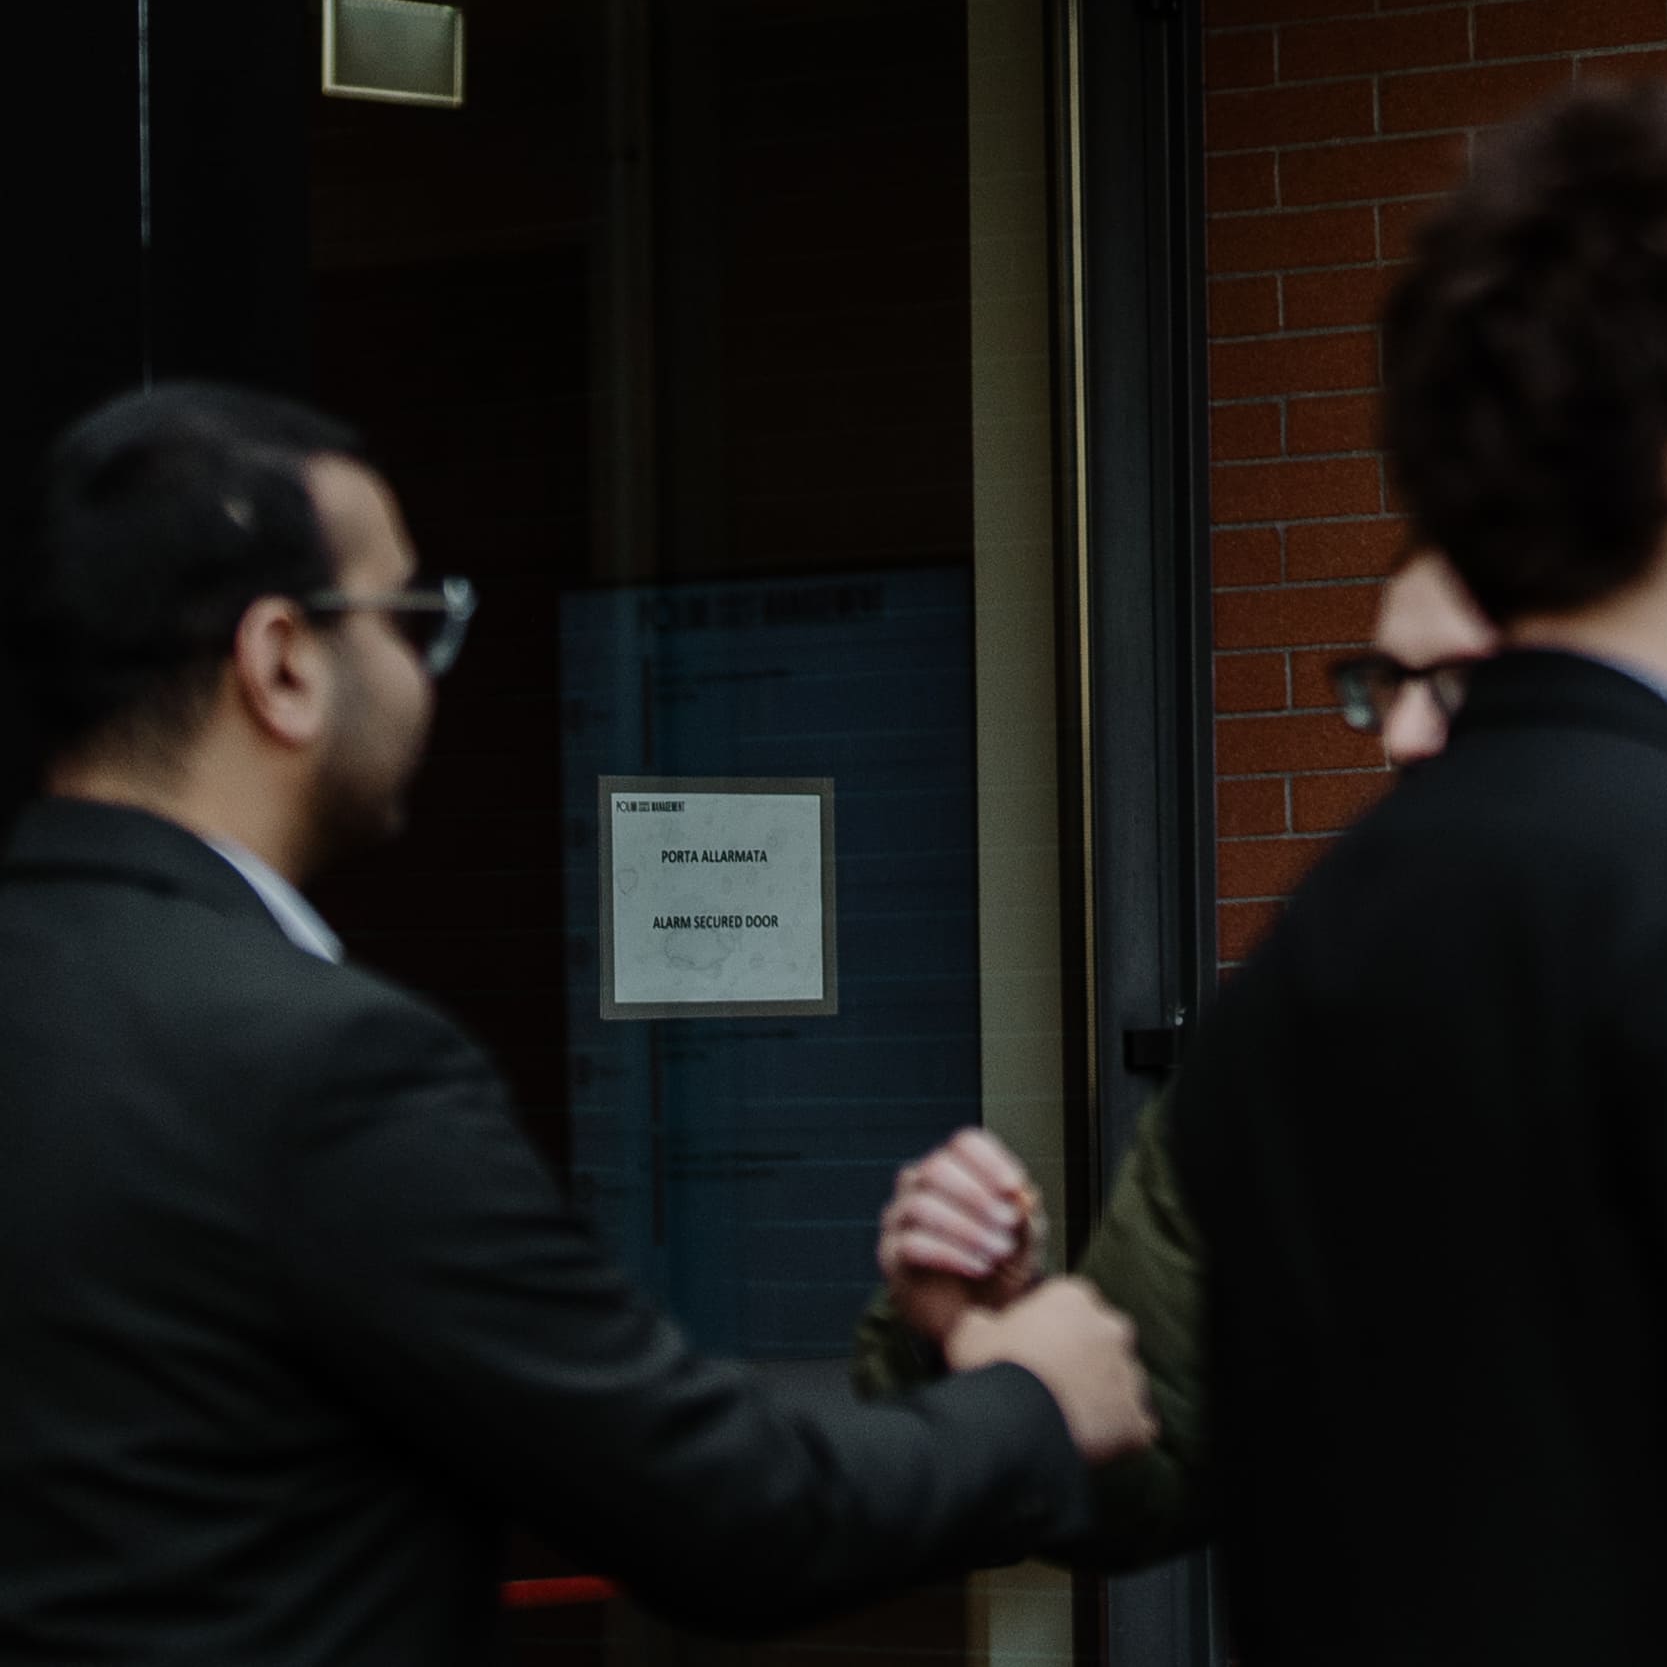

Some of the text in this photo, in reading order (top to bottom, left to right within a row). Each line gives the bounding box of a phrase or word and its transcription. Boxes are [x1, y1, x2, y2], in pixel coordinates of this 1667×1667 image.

[661, 850, 767, 863] PORTA ALLARMATA
[652, 914, 778, 929] ALARM SECURED DOOR
